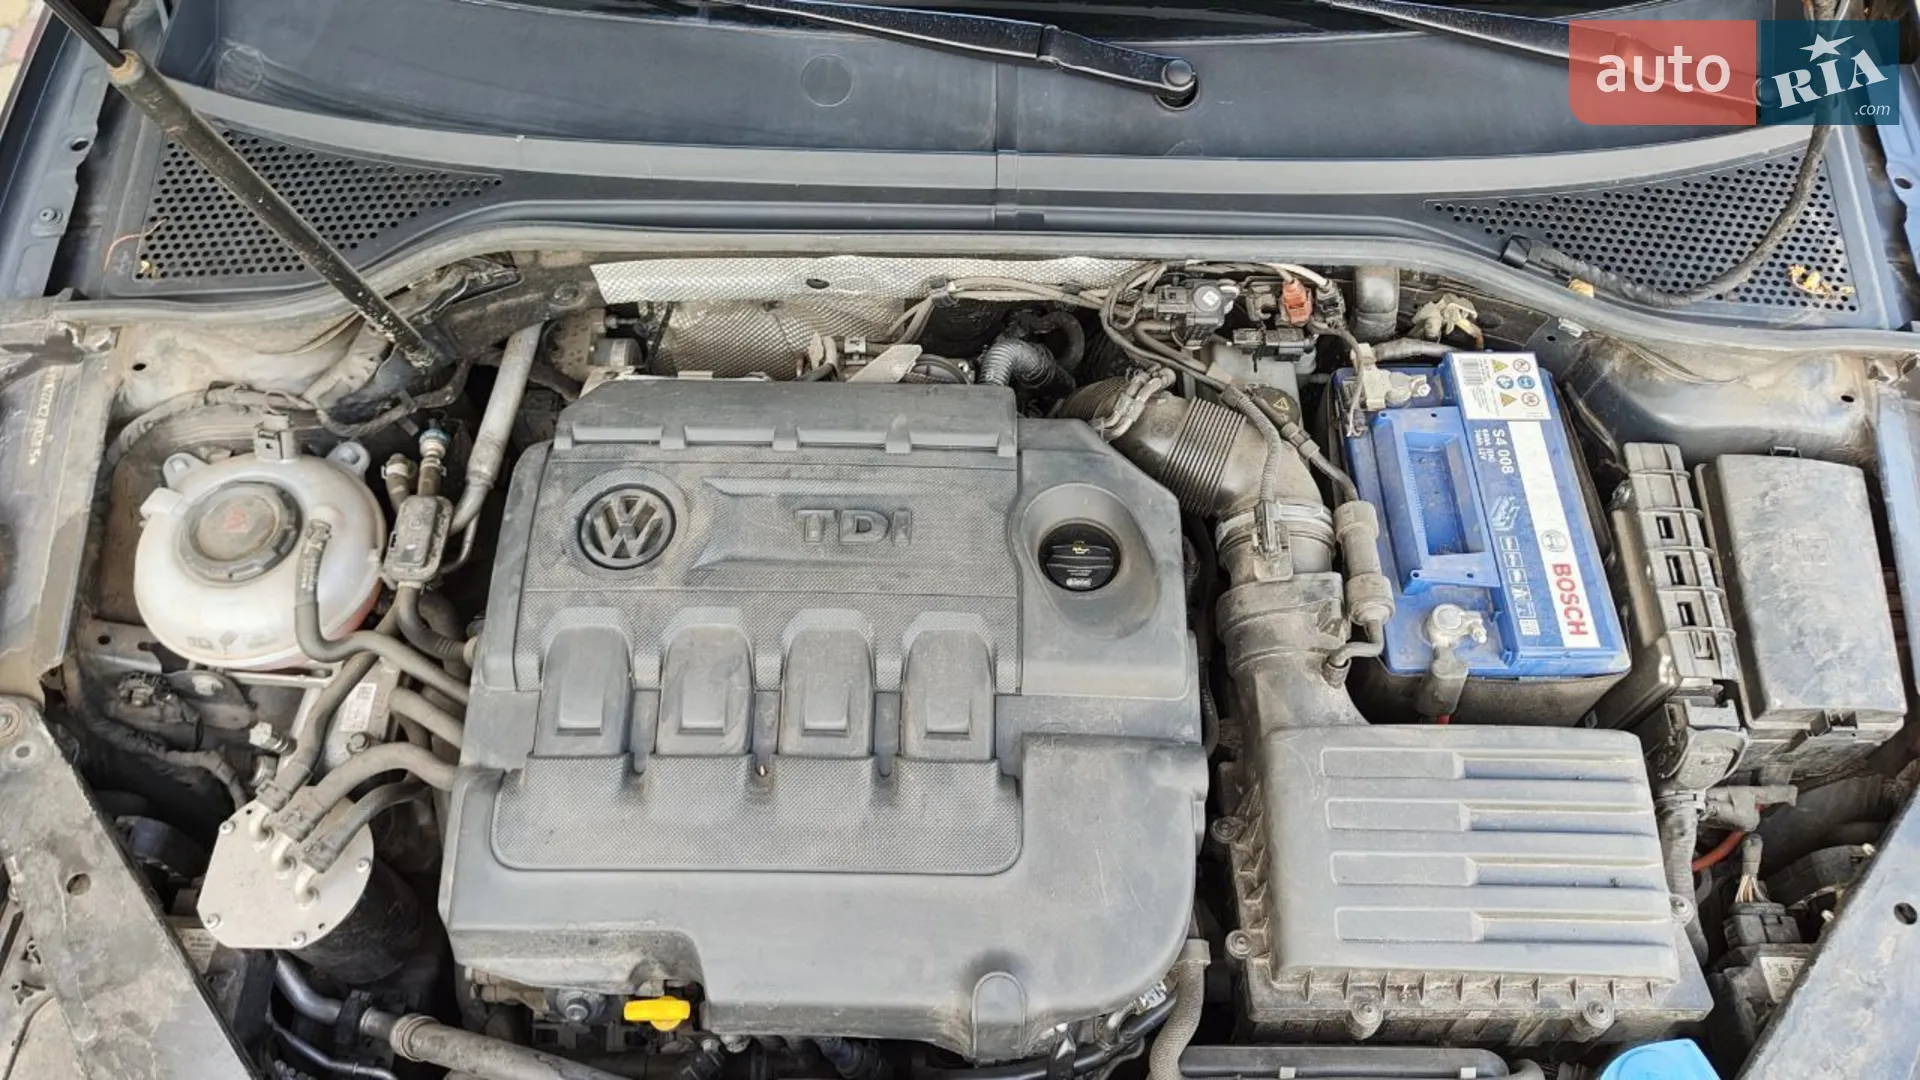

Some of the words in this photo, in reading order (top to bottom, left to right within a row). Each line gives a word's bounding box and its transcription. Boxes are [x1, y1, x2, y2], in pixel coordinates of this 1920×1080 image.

[1492, 428, 1508, 446] S4
[1498, 449, 1515, 474] 008
[795, 507, 913, 547] TDI
[1551, 563, 1589, 636] BOSCH
